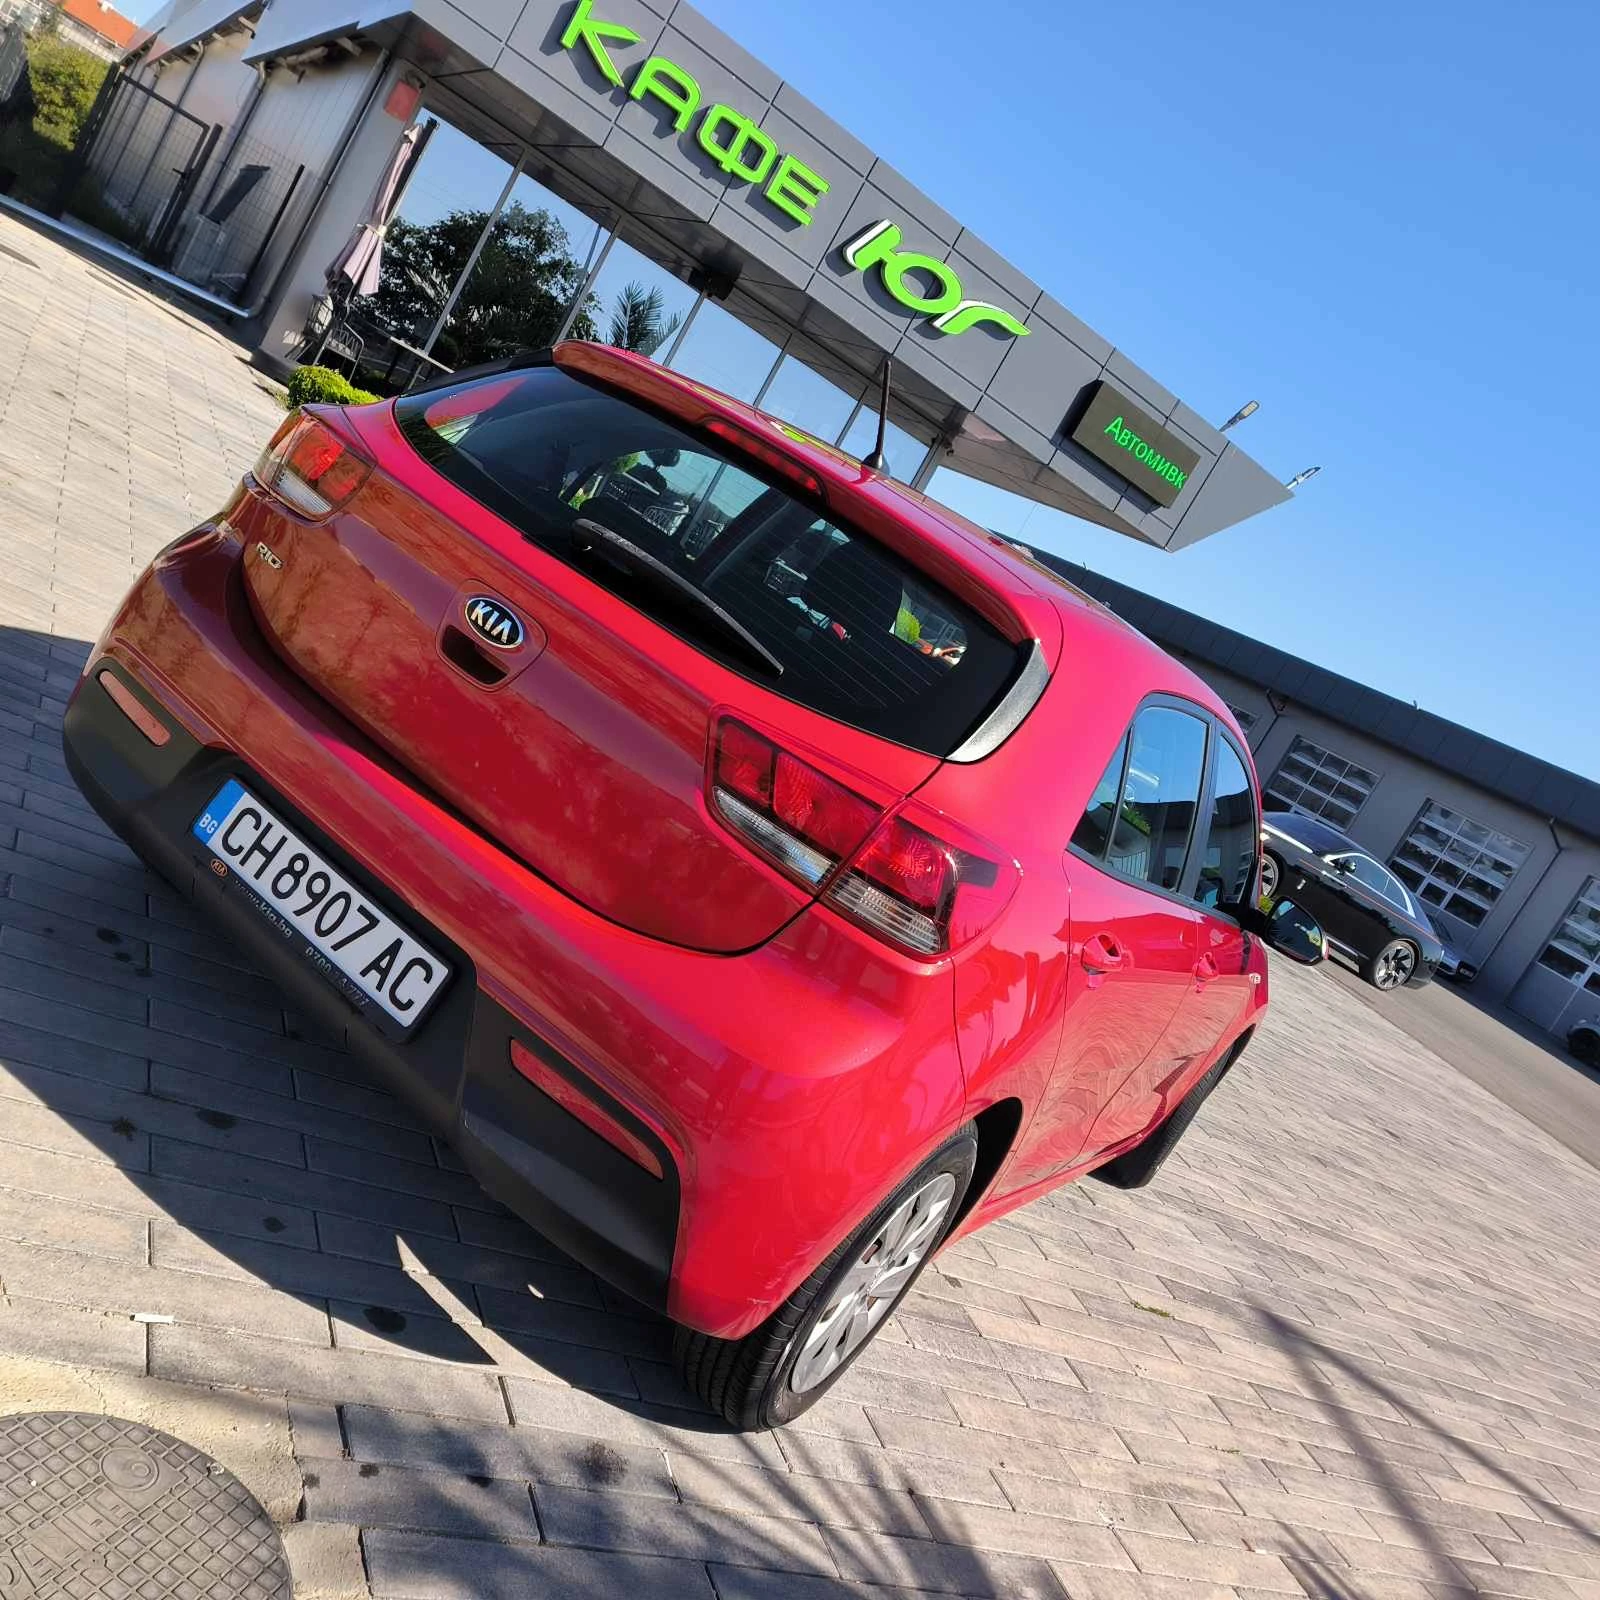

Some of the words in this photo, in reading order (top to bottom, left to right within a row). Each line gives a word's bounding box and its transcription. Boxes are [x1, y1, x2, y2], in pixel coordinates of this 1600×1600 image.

[561, 0, 831, 226] КАФЕ
[256, 541, 283, 569] RIO
[469, 600, 513, 644] KIA
[199, 813, 218, 834] BG
[212, 860, 227, 876] KIA
[359, 937, 433, 1012] AC
